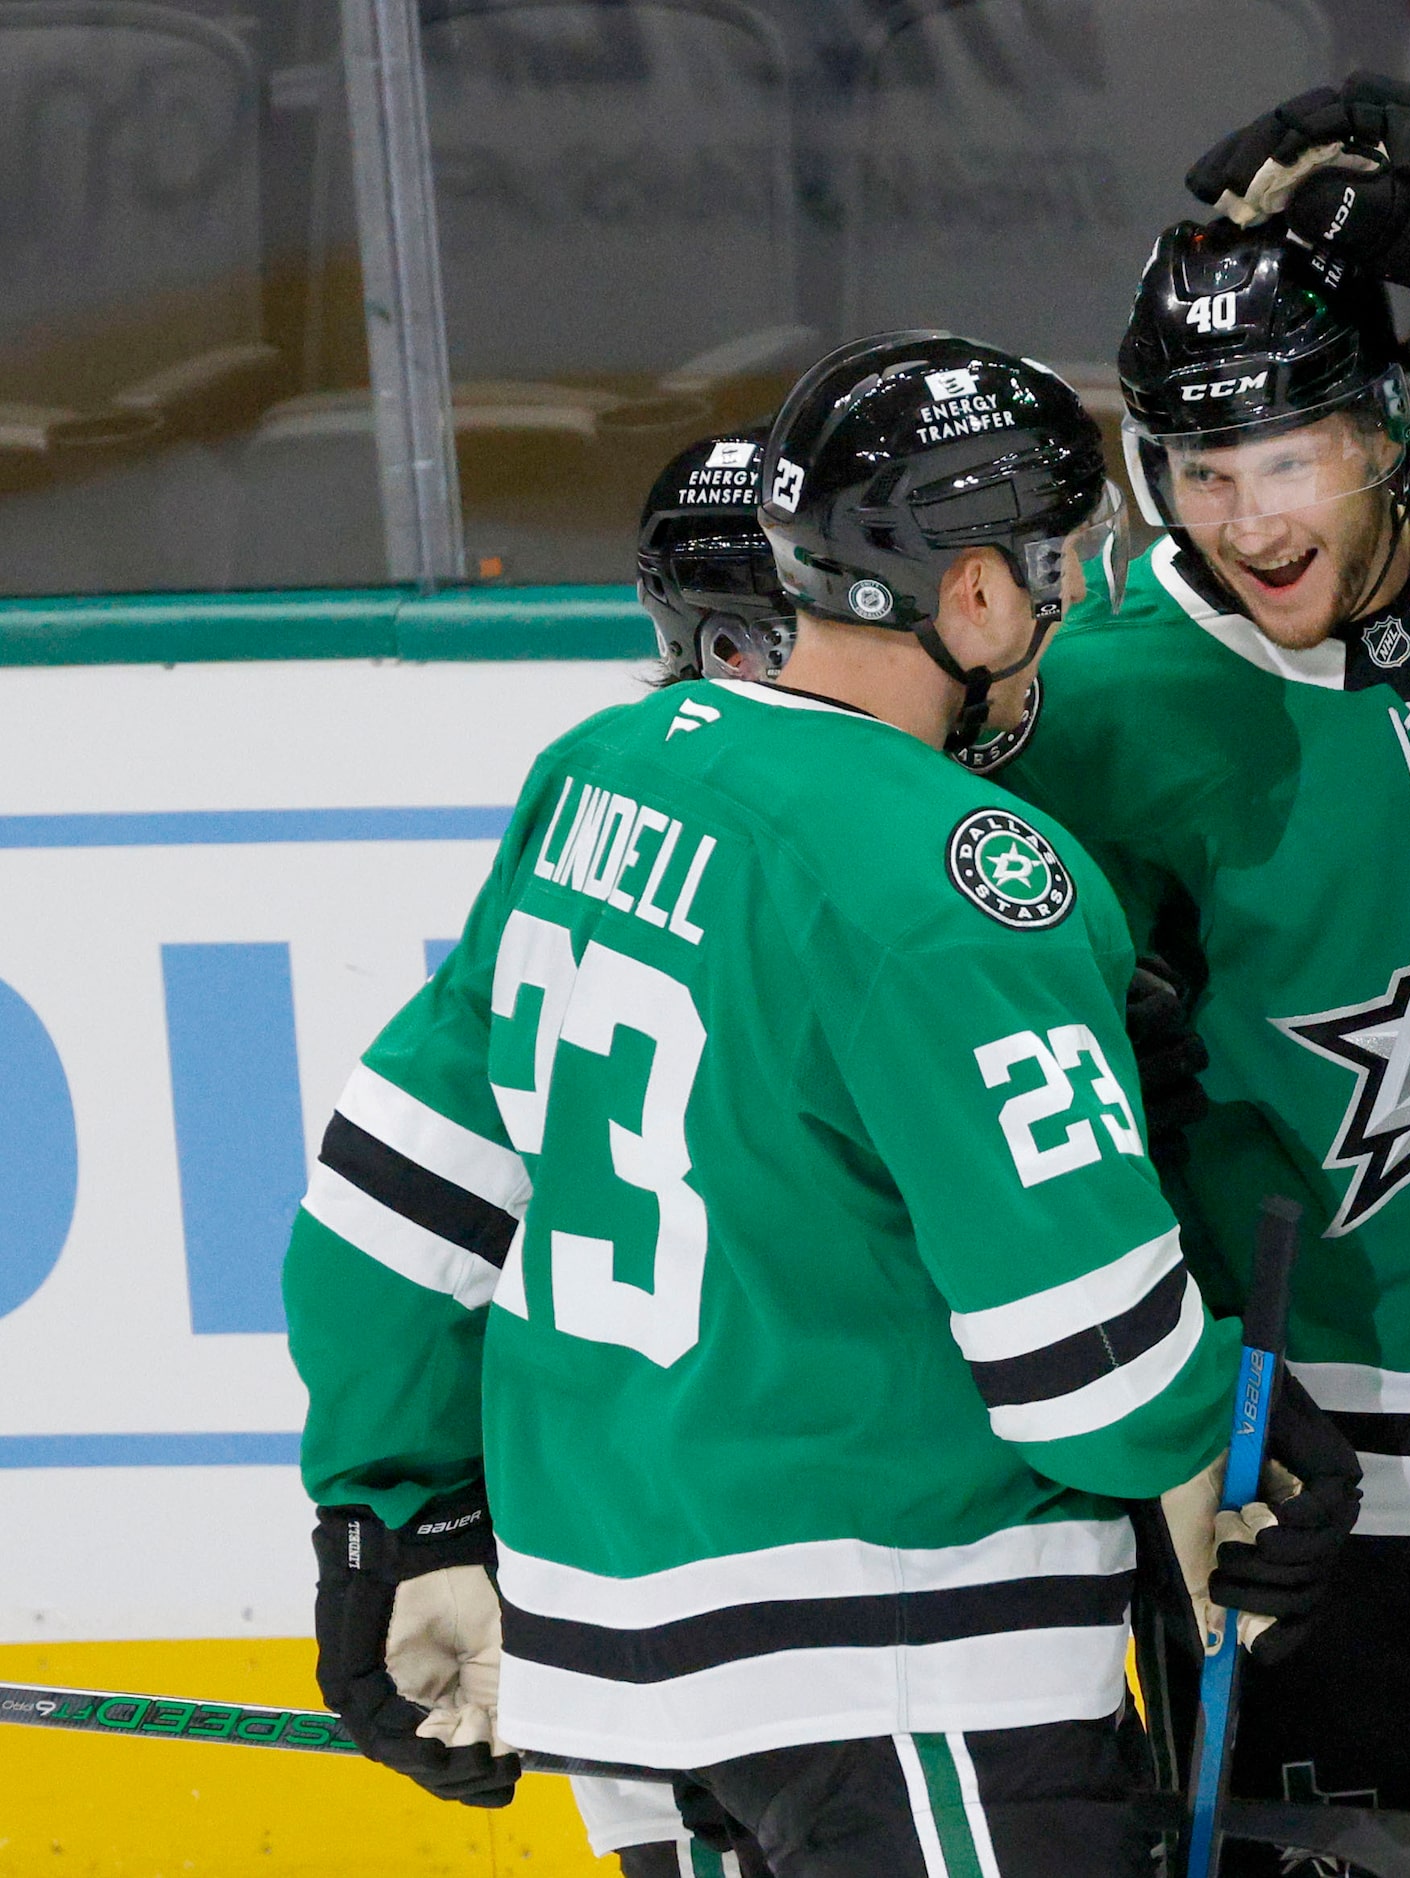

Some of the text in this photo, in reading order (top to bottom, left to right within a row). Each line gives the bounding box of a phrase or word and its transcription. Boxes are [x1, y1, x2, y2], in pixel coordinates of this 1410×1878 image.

[1324, 187, 1356, 240] CCM
[1186, 291, 1237, 333] 40
[1180, 371, 1268, 401] CCM
[916, 410, 1016, 444] TRANSFER
[920, 394, 998, 424] ENERGY
[689, 471, 759, 486] ENERGY
[773, 457, 805, 514] 23
[1379, 628, 1398, 661] NHL
[533, 775, 718, 946] LINDELL
[960, 818, 1057, 865] DALLAS
[975, 884, 1064, 919] STARS
[973, 1023, 1145, 1188] 23
[489, 909, 708, 1370] 23
[348, 1521, 361, 1570] LINDELL
